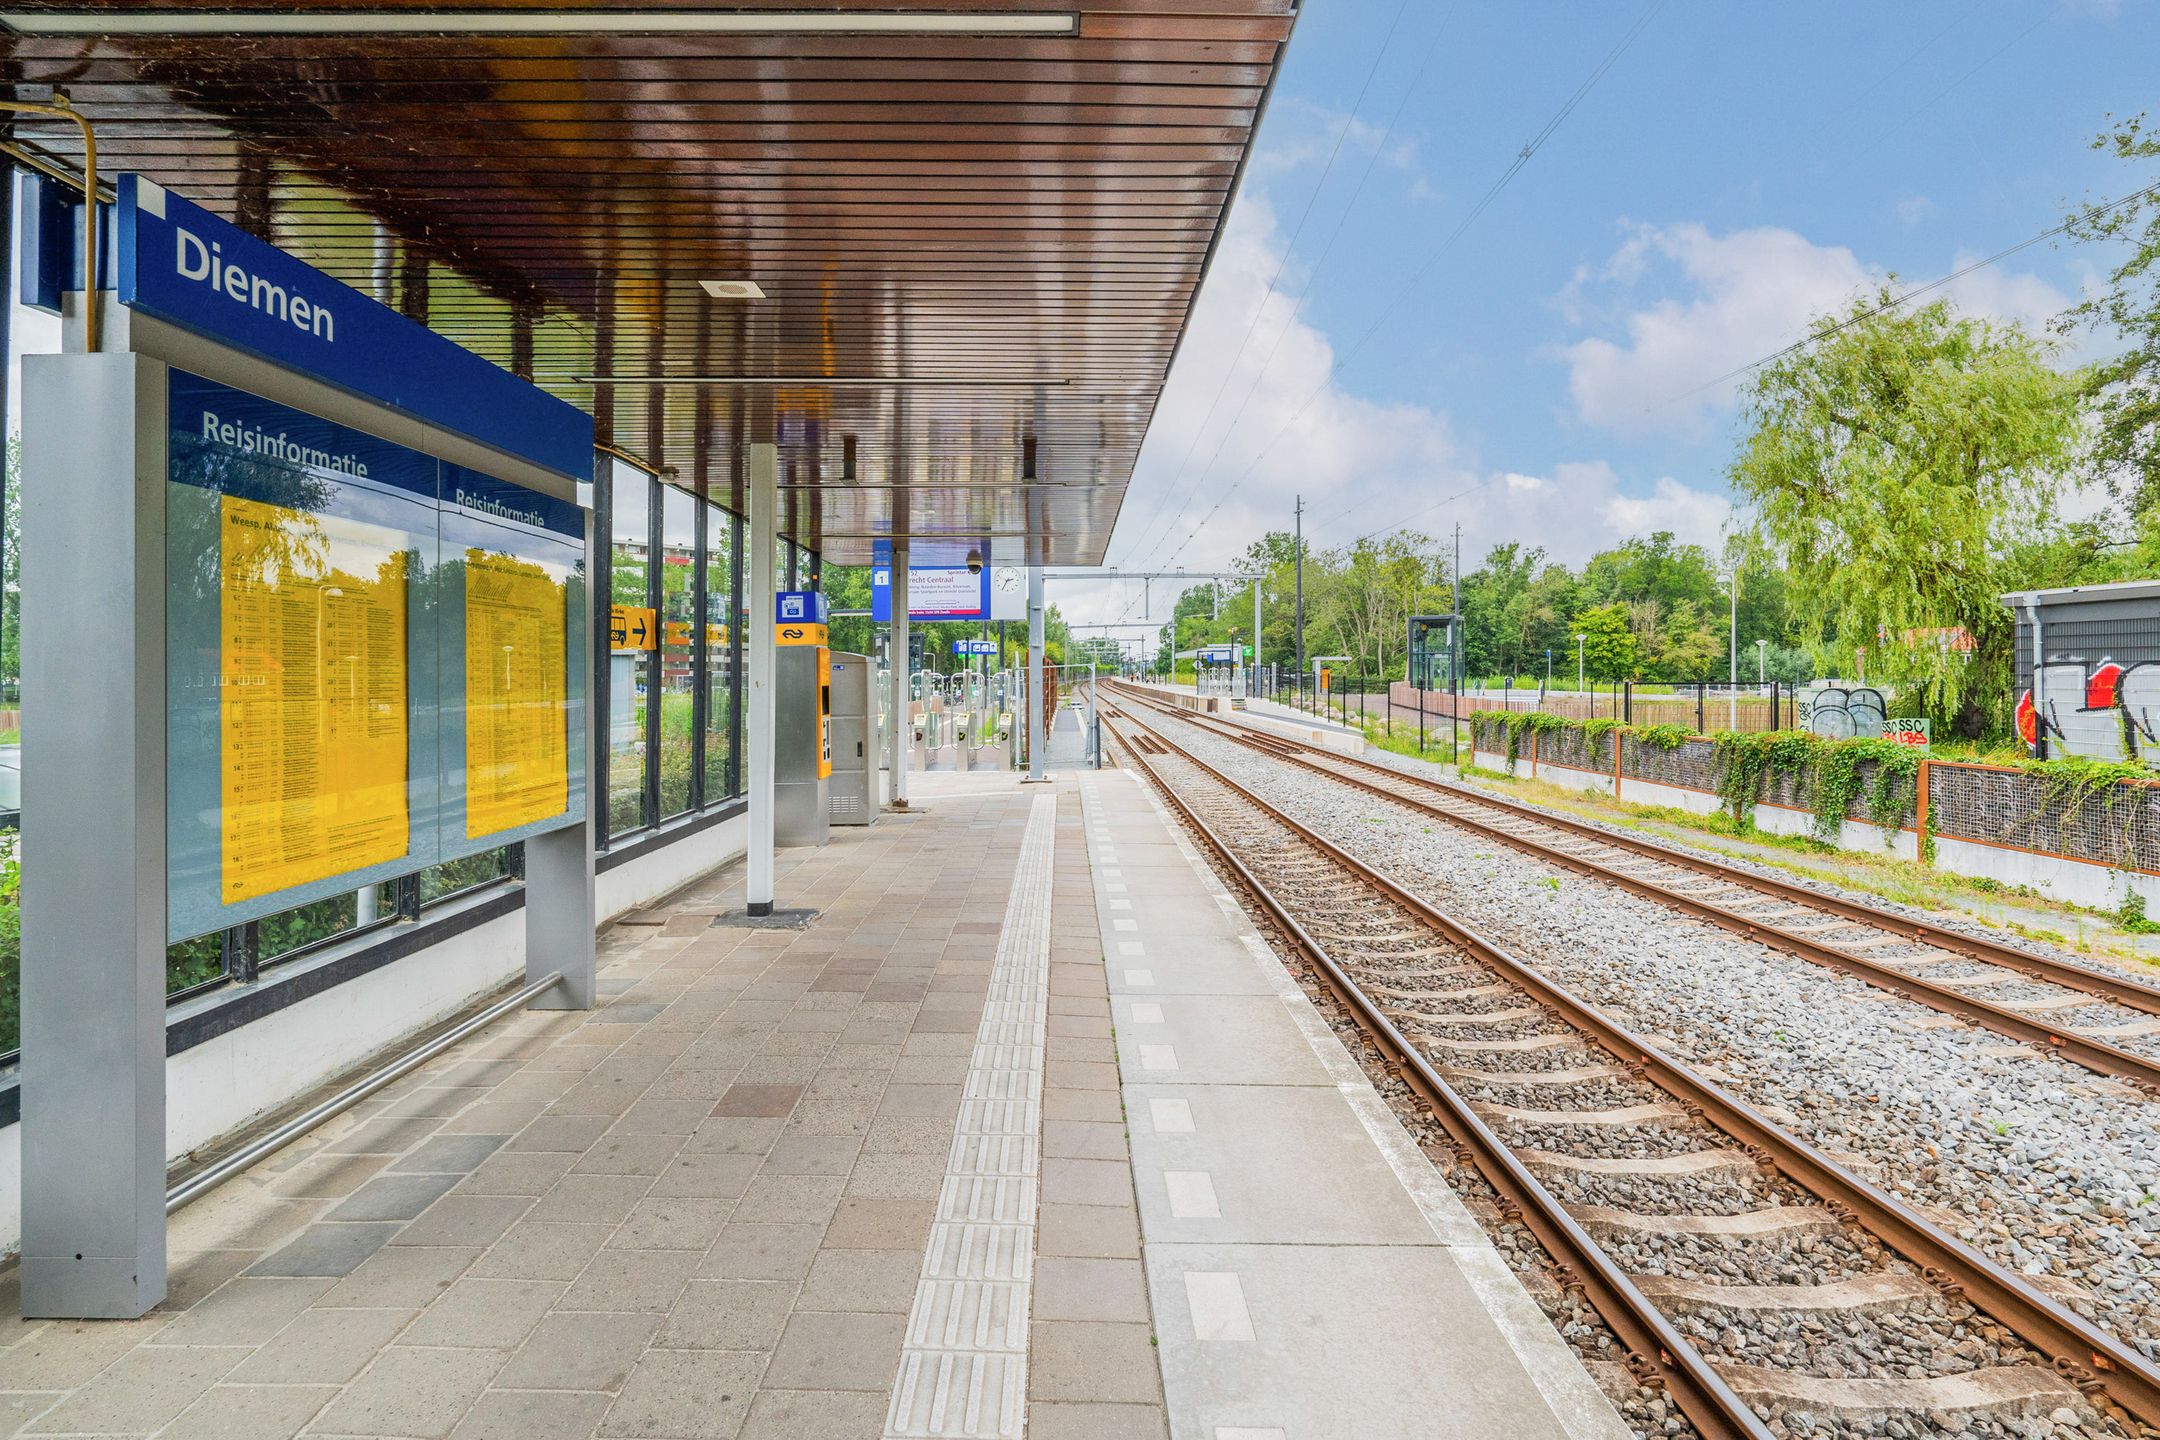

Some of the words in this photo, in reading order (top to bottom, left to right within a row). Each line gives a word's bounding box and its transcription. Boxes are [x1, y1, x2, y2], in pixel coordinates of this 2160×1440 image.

[177, 227, 334, 343] Diemen
[203, 411, 368, 478] Reisinformatie
[456, 488, 545, 527] Reisinformatie
[230, 515, 262, 530] Weesp,
[879, 576, 884, 584] 1
[1899, 719, 1925, 733] SSC
